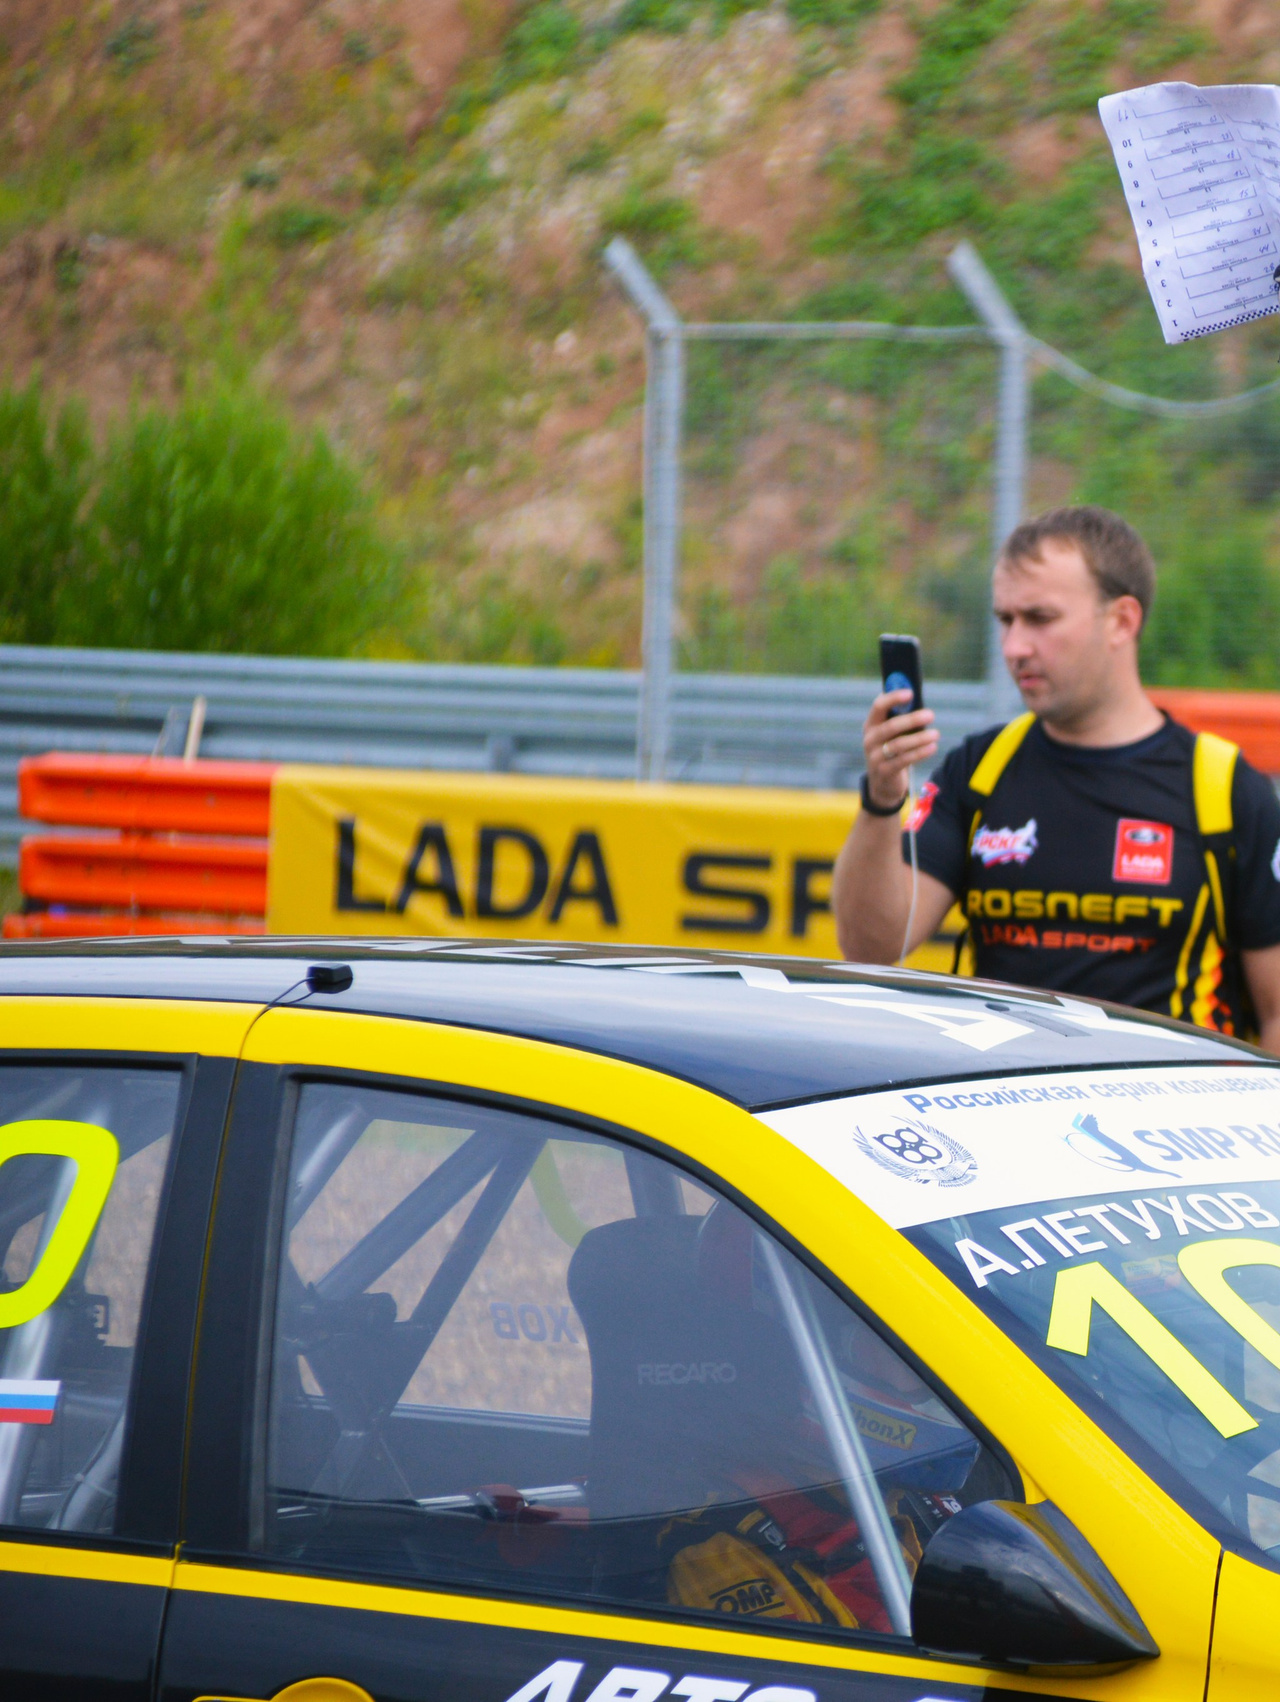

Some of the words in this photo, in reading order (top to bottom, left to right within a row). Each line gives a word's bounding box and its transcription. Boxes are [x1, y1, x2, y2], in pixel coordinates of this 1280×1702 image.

[333, 815, 620, 928] LADA
[967, 889, 1184, 928] ROSNEFT
[980, 924, 1038, 947] LADA
[1041, 930, 1156, 953] SPORT
[902, 1086, 1091, 1113] Российская
[1088, 1080, 1168, 1102] серия
[1164, 1077, 1276, 1095] кольцевых
[1133, 1126, 1240, 1161] SMP
[954, 1191, 1280, 1289] А.ПЕТУХОВ
[637, 1362, 737, 1386] RECARO
[714, 1583, 776, 1614] OMP
